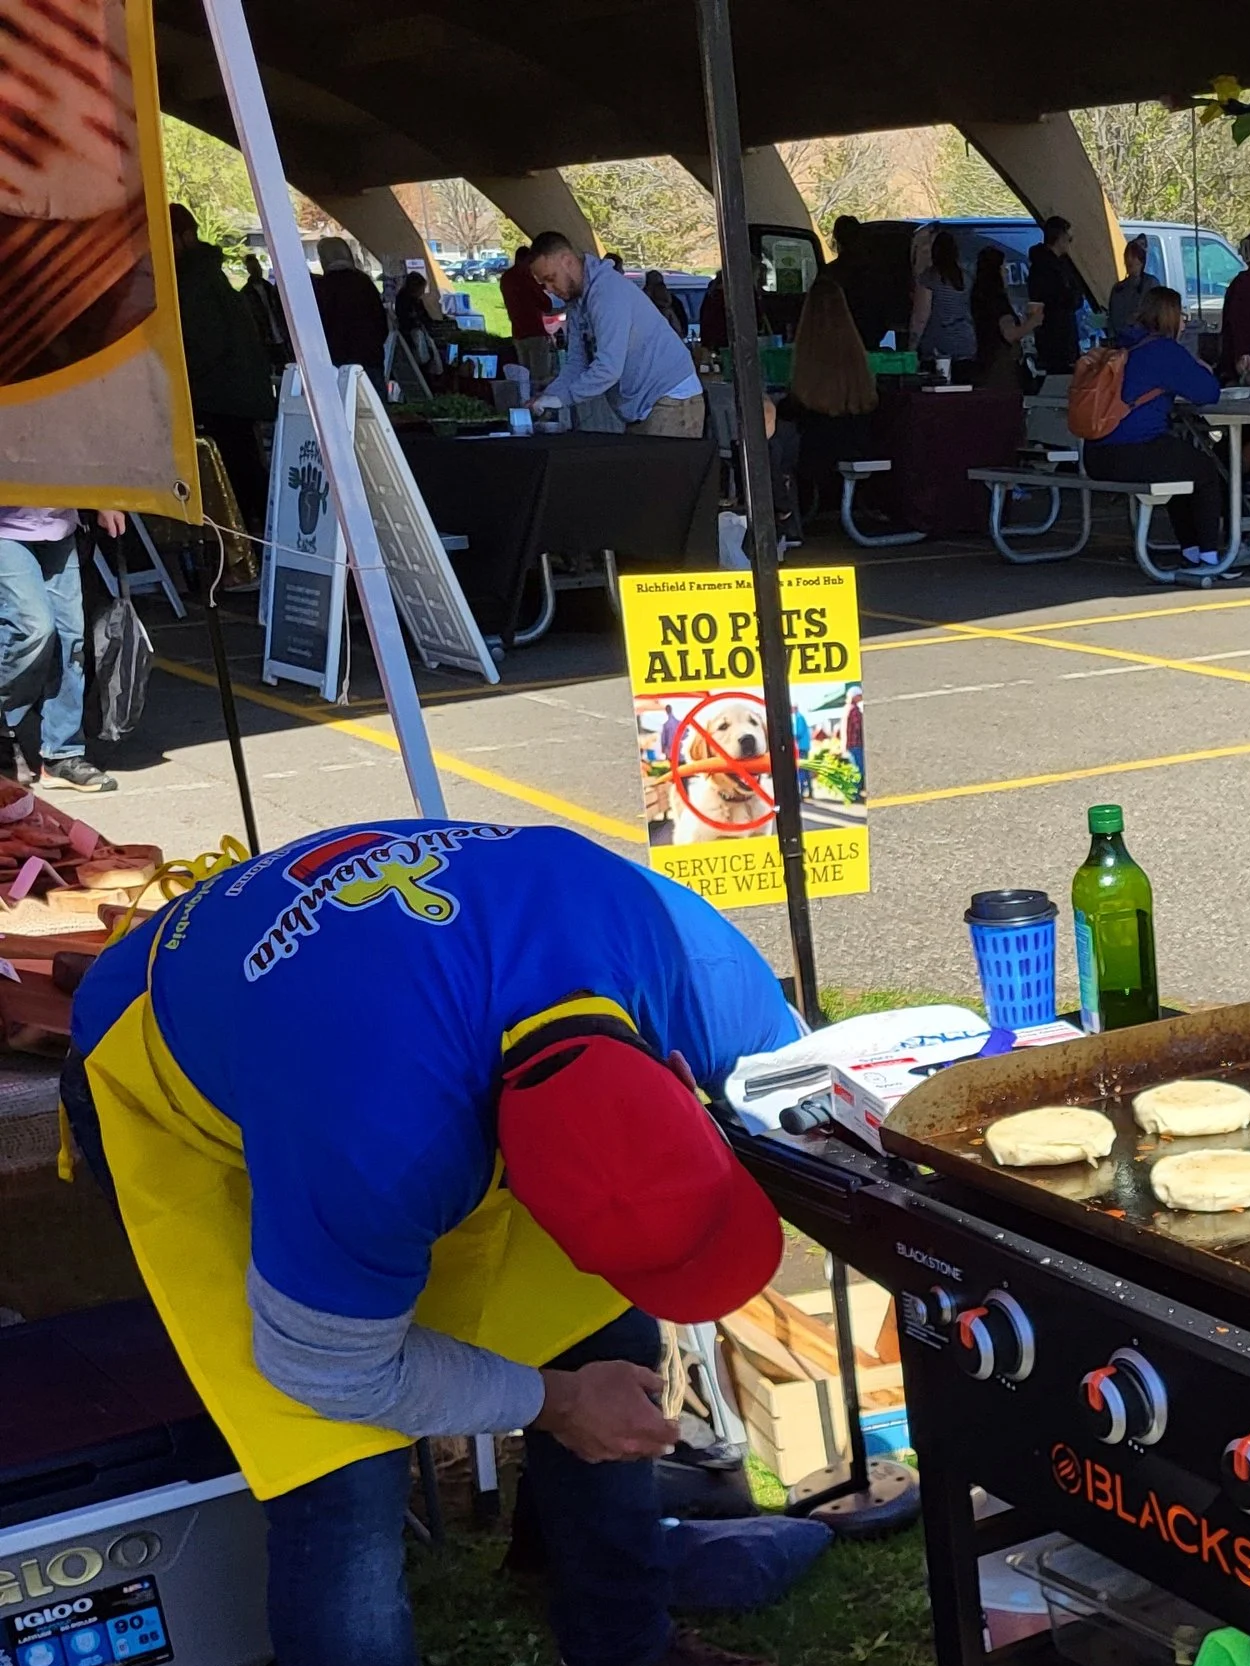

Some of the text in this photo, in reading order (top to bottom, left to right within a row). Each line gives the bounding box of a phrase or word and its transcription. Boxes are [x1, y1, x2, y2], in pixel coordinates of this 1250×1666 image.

[636, 581, 686, 593] Richfield
[689, 580, 733, 591] Farmers
[796, 576, 821, 587] Food
[823, 575, 844, 586] Hub
[659, 607, 828, 646] NO PTS
[664, 842, 860, 879] SERVICE AMALS
[733, 863, 845, 893] WELME
[896, 1241, 964, 1282] BLACKSTONE
[14, 1597, 93, 1632] IGLOO
[113, 1614, 144, 1635] 90
